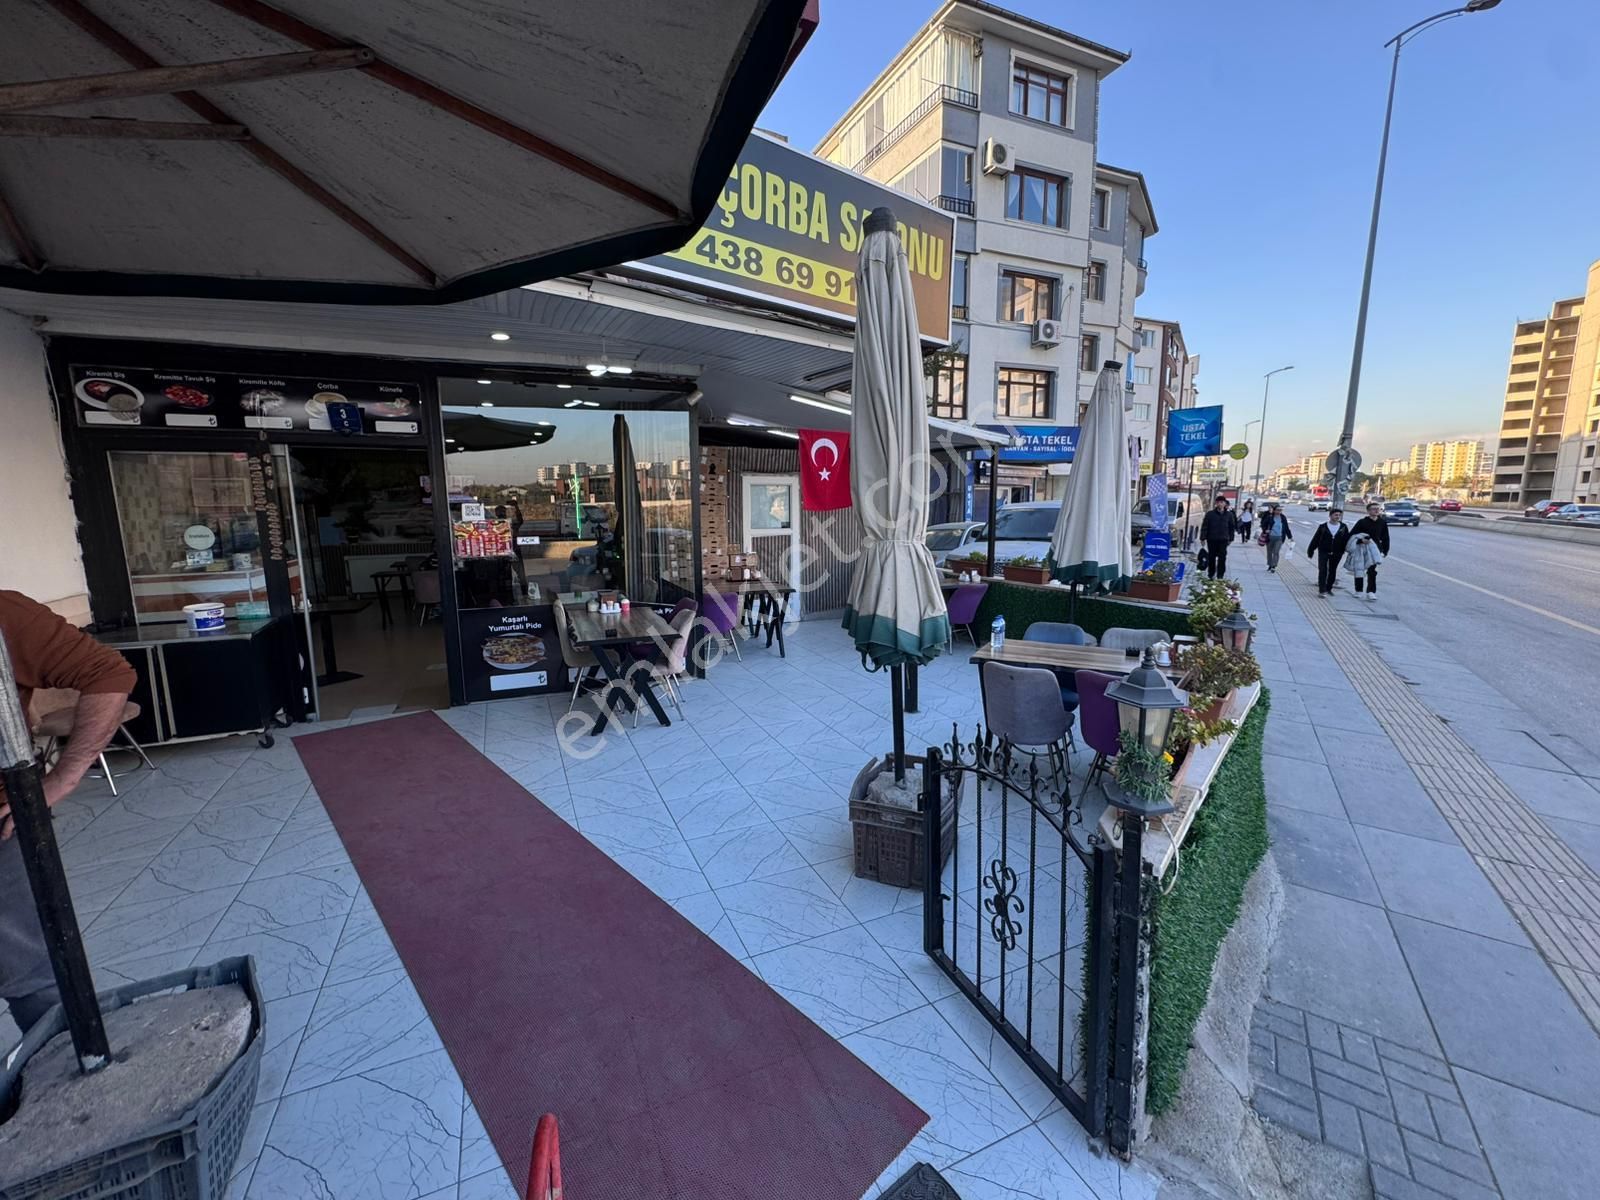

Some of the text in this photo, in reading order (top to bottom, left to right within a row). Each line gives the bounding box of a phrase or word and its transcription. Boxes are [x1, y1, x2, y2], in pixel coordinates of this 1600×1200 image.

[840, 201, 944, 281] SNU
[696, 234, 856, 302] 438 69 91
[317, 382, 339, 391] Çorba
[1182, 423, 1206, 432] USTA
[1041, 435, 1073, 445] TEKEL
[1180, 432, 1208, 441] TEKEL
[501, 615, 528, 624] Kaşarlı
[488, 622, 542, 633] Yumurtalı Pide
